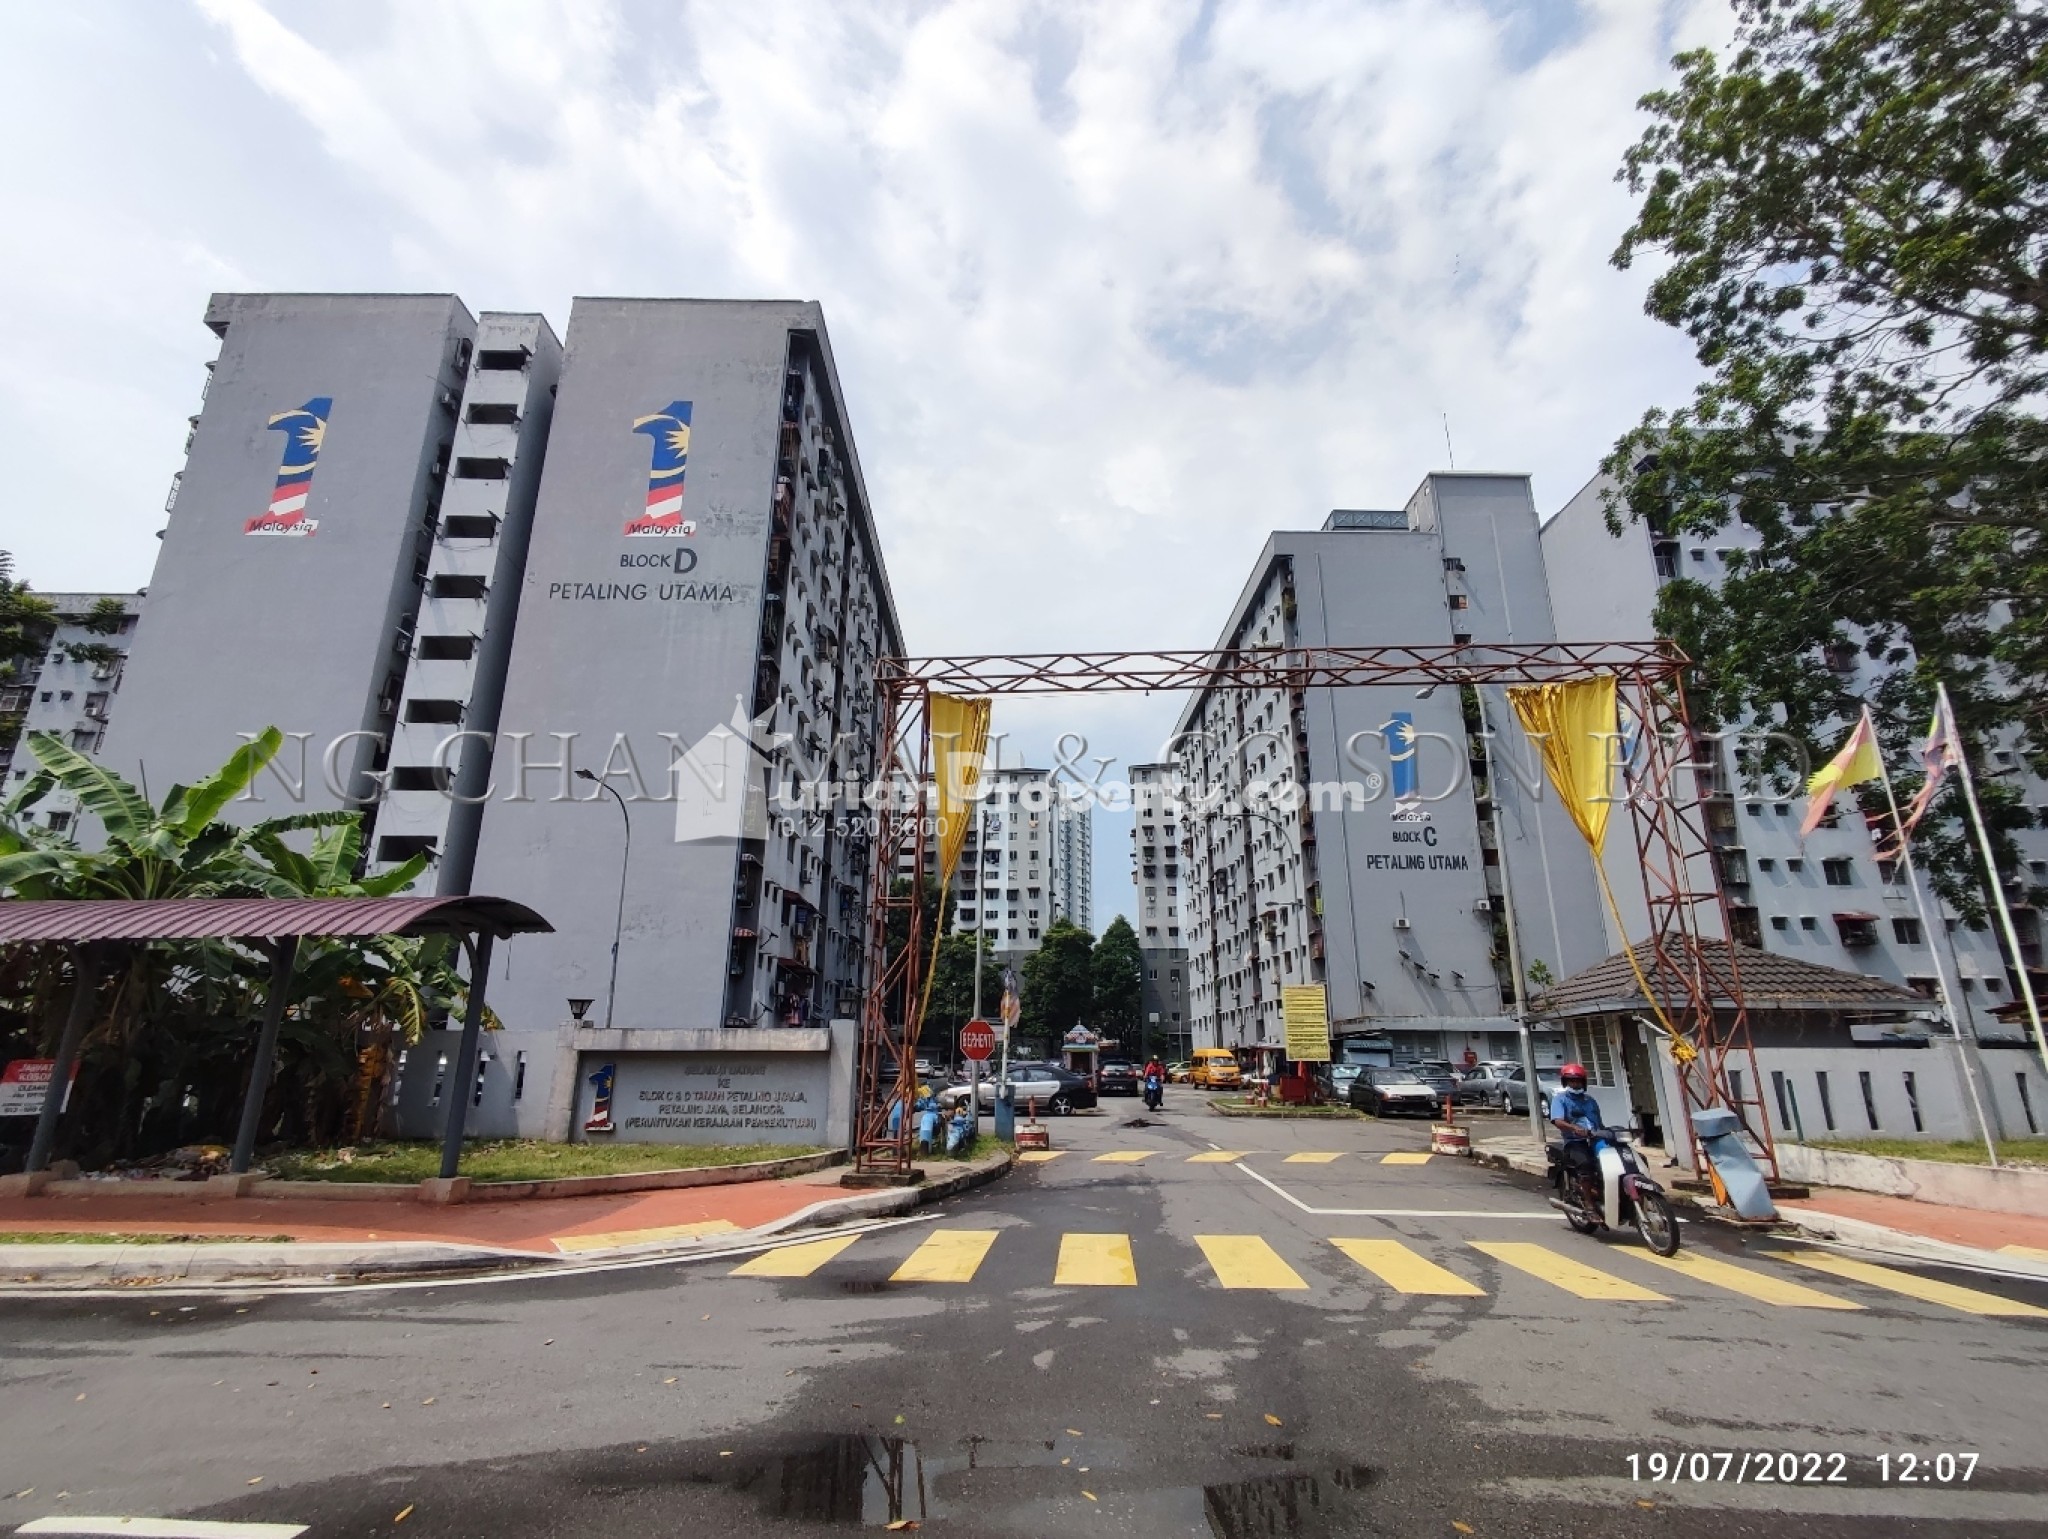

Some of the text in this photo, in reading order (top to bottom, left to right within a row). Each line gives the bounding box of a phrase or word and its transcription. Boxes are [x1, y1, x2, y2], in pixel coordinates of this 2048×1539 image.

[249, 519, 314, 534] Malaysia
[627, 522, 692, 537] Malaysia
[620, 547, 698, 574] BLOCK D
[549, 583, 733, 601] PETALING UTAMA
[1392, 826, 1437, 847] BLOCK C
[1367, 854, 1469, 870] PETALING UTAMA
[962, 1032, 994, 1048] BERHENTI
[718, 1079, 731, 1088] KE
[638, 1091, 664, 1101] BLOK
[666, 1091, 673, 1101] C
[684, 1091, 691, 1101] D
[693, 1091, 725, 1102] TAMAN
[727, 1091, 772, 1102] PETALING
[659, 1104, 703, 1115] PETALING
[693, 1117, 743, 1128] KERAJAAN
